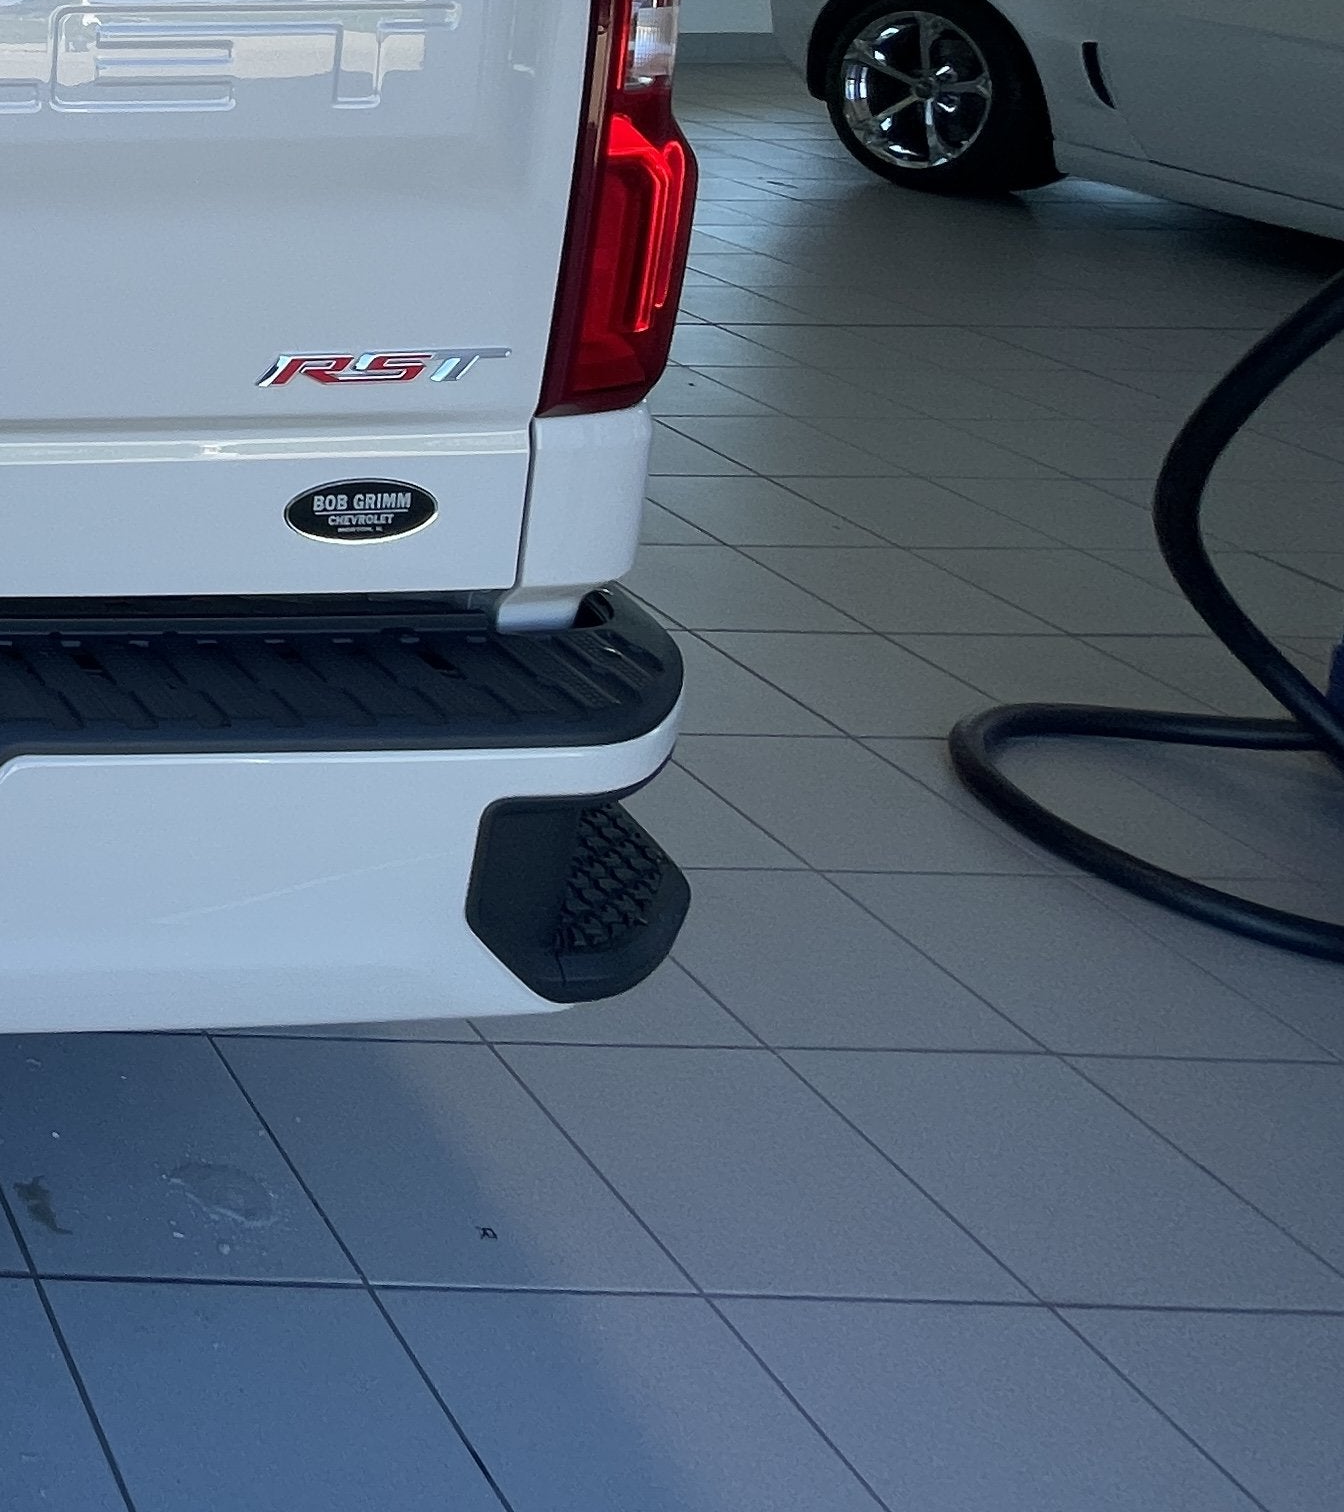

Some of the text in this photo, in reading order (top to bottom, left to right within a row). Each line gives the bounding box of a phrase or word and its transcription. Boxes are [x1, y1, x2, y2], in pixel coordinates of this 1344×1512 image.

[255, 346, 512, 387] RST
[313, 492, 412, 511] BOB GRIMM
[328, 513, 394, 526] CHEVROLET
